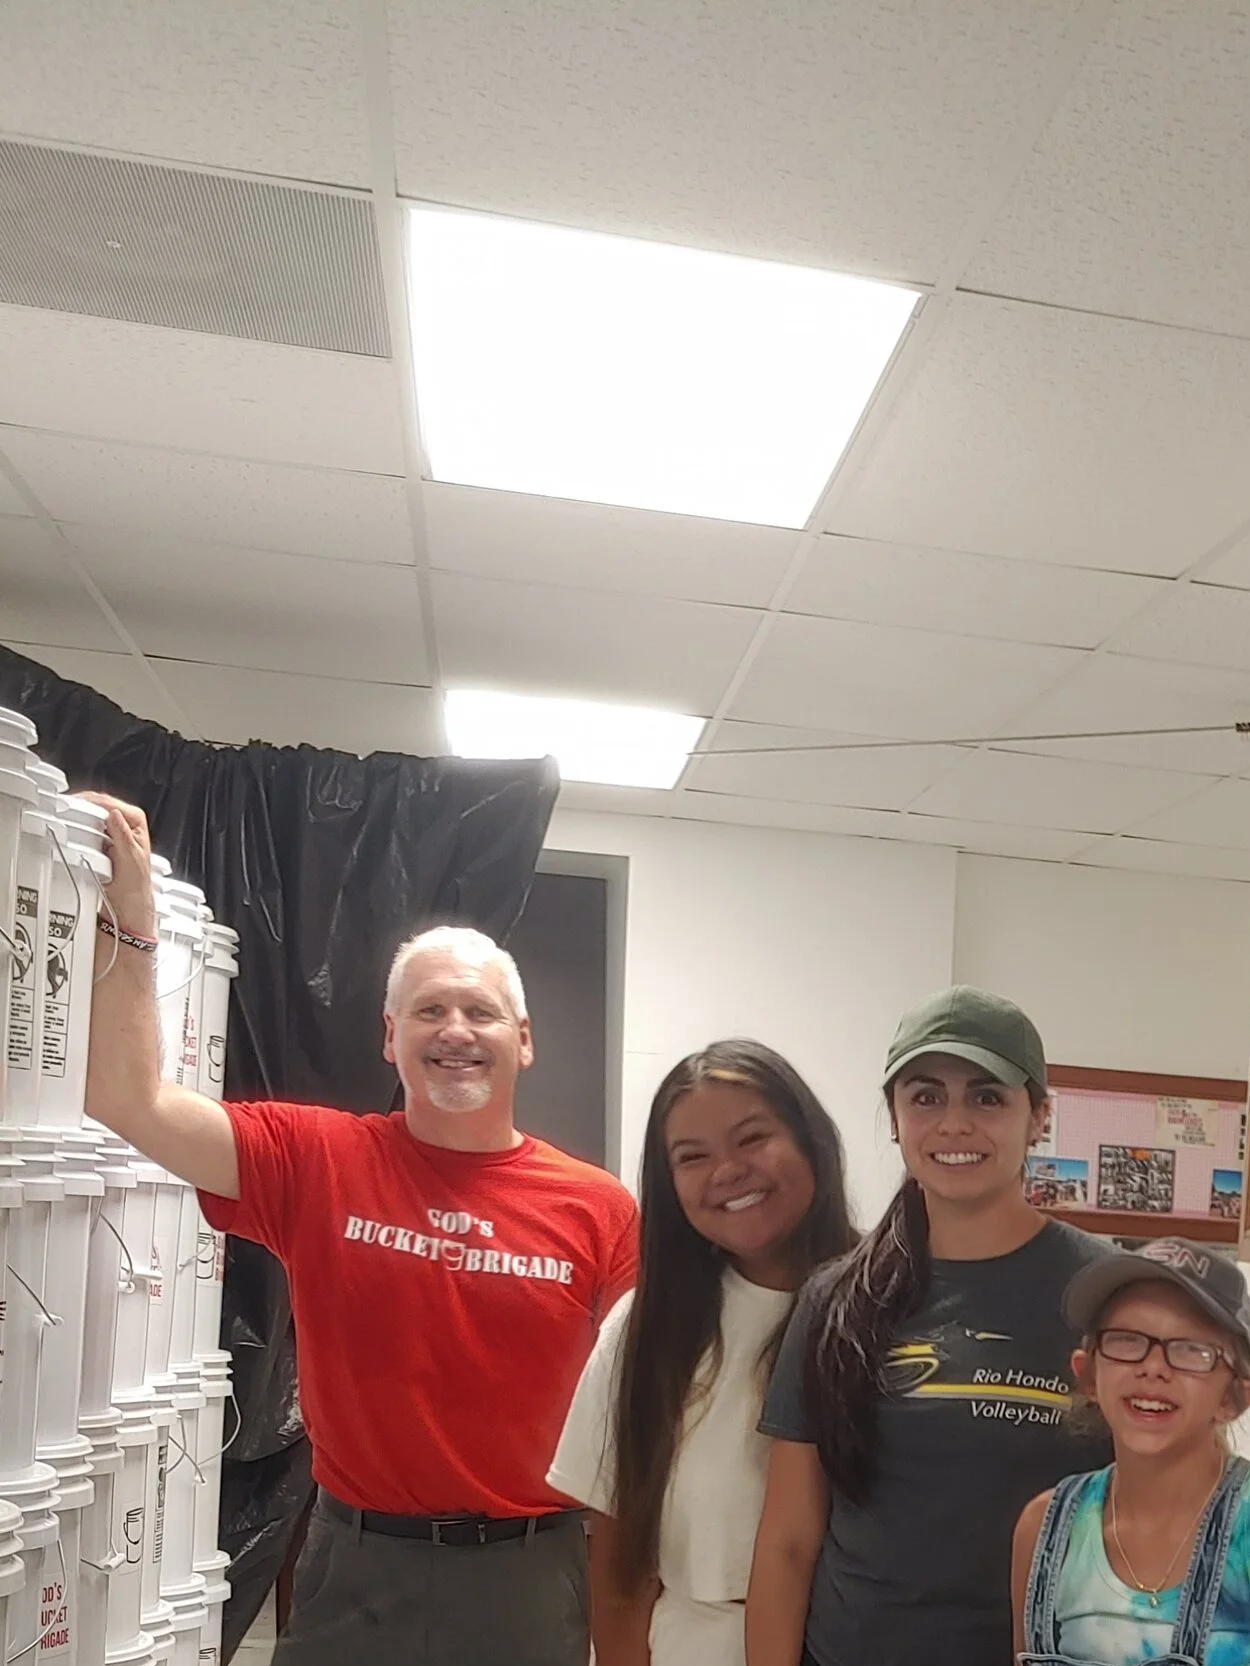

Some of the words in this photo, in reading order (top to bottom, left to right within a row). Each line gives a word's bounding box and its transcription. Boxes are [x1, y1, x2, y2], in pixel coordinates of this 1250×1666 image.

[343, 1215, 441, 1261] BUCKET
[464, 1249, 573, 1285] BRIGADE
[972, 1367, 1002, 1384] Rio
[1005, 1369, 1070, 1394] Hondo
[971, 1401, 1062, 1426] Volleyball
[42, 1581, 63, 1603] OD'S
[40, 1627, 70, 1650] RIGADE
